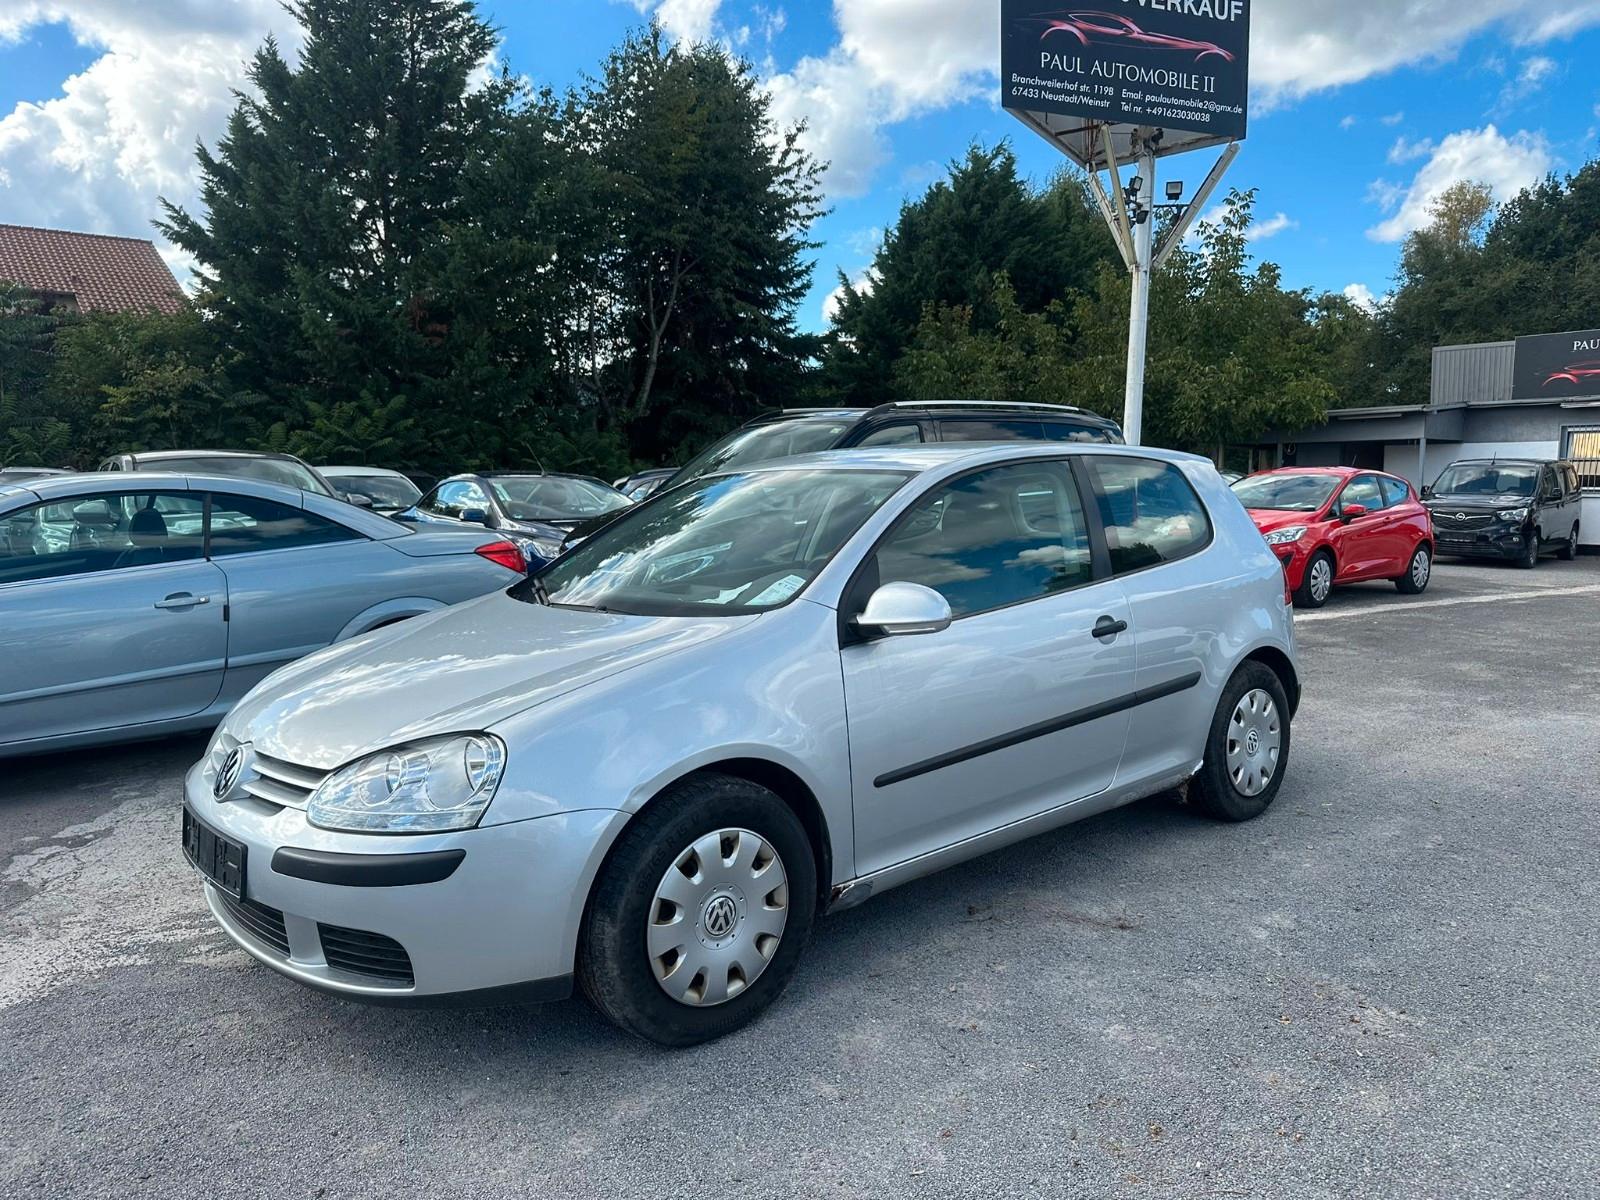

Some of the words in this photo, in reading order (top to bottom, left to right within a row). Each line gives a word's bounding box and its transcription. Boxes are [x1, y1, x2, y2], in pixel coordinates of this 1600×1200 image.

[1011, 73, 1078, 91] Branchweilerhof
[1080, 83, 1091, 93] str.
[1041, 52, 1085, 74] PAUL
[1091, 60, 1199, 91] AUTOMOBILE
[1203, 76, 1215, 93] II
[1011, 86, 1039, 98] 67433
[1041, 90, 1110, 108] Neustadt/Weinstr
[1145, 93, 1243, 114] paulautomobile2@gmx.de
[1120, 101, 1132, 112] Tel
[1146, 106, 1210, 122] +491623030038
